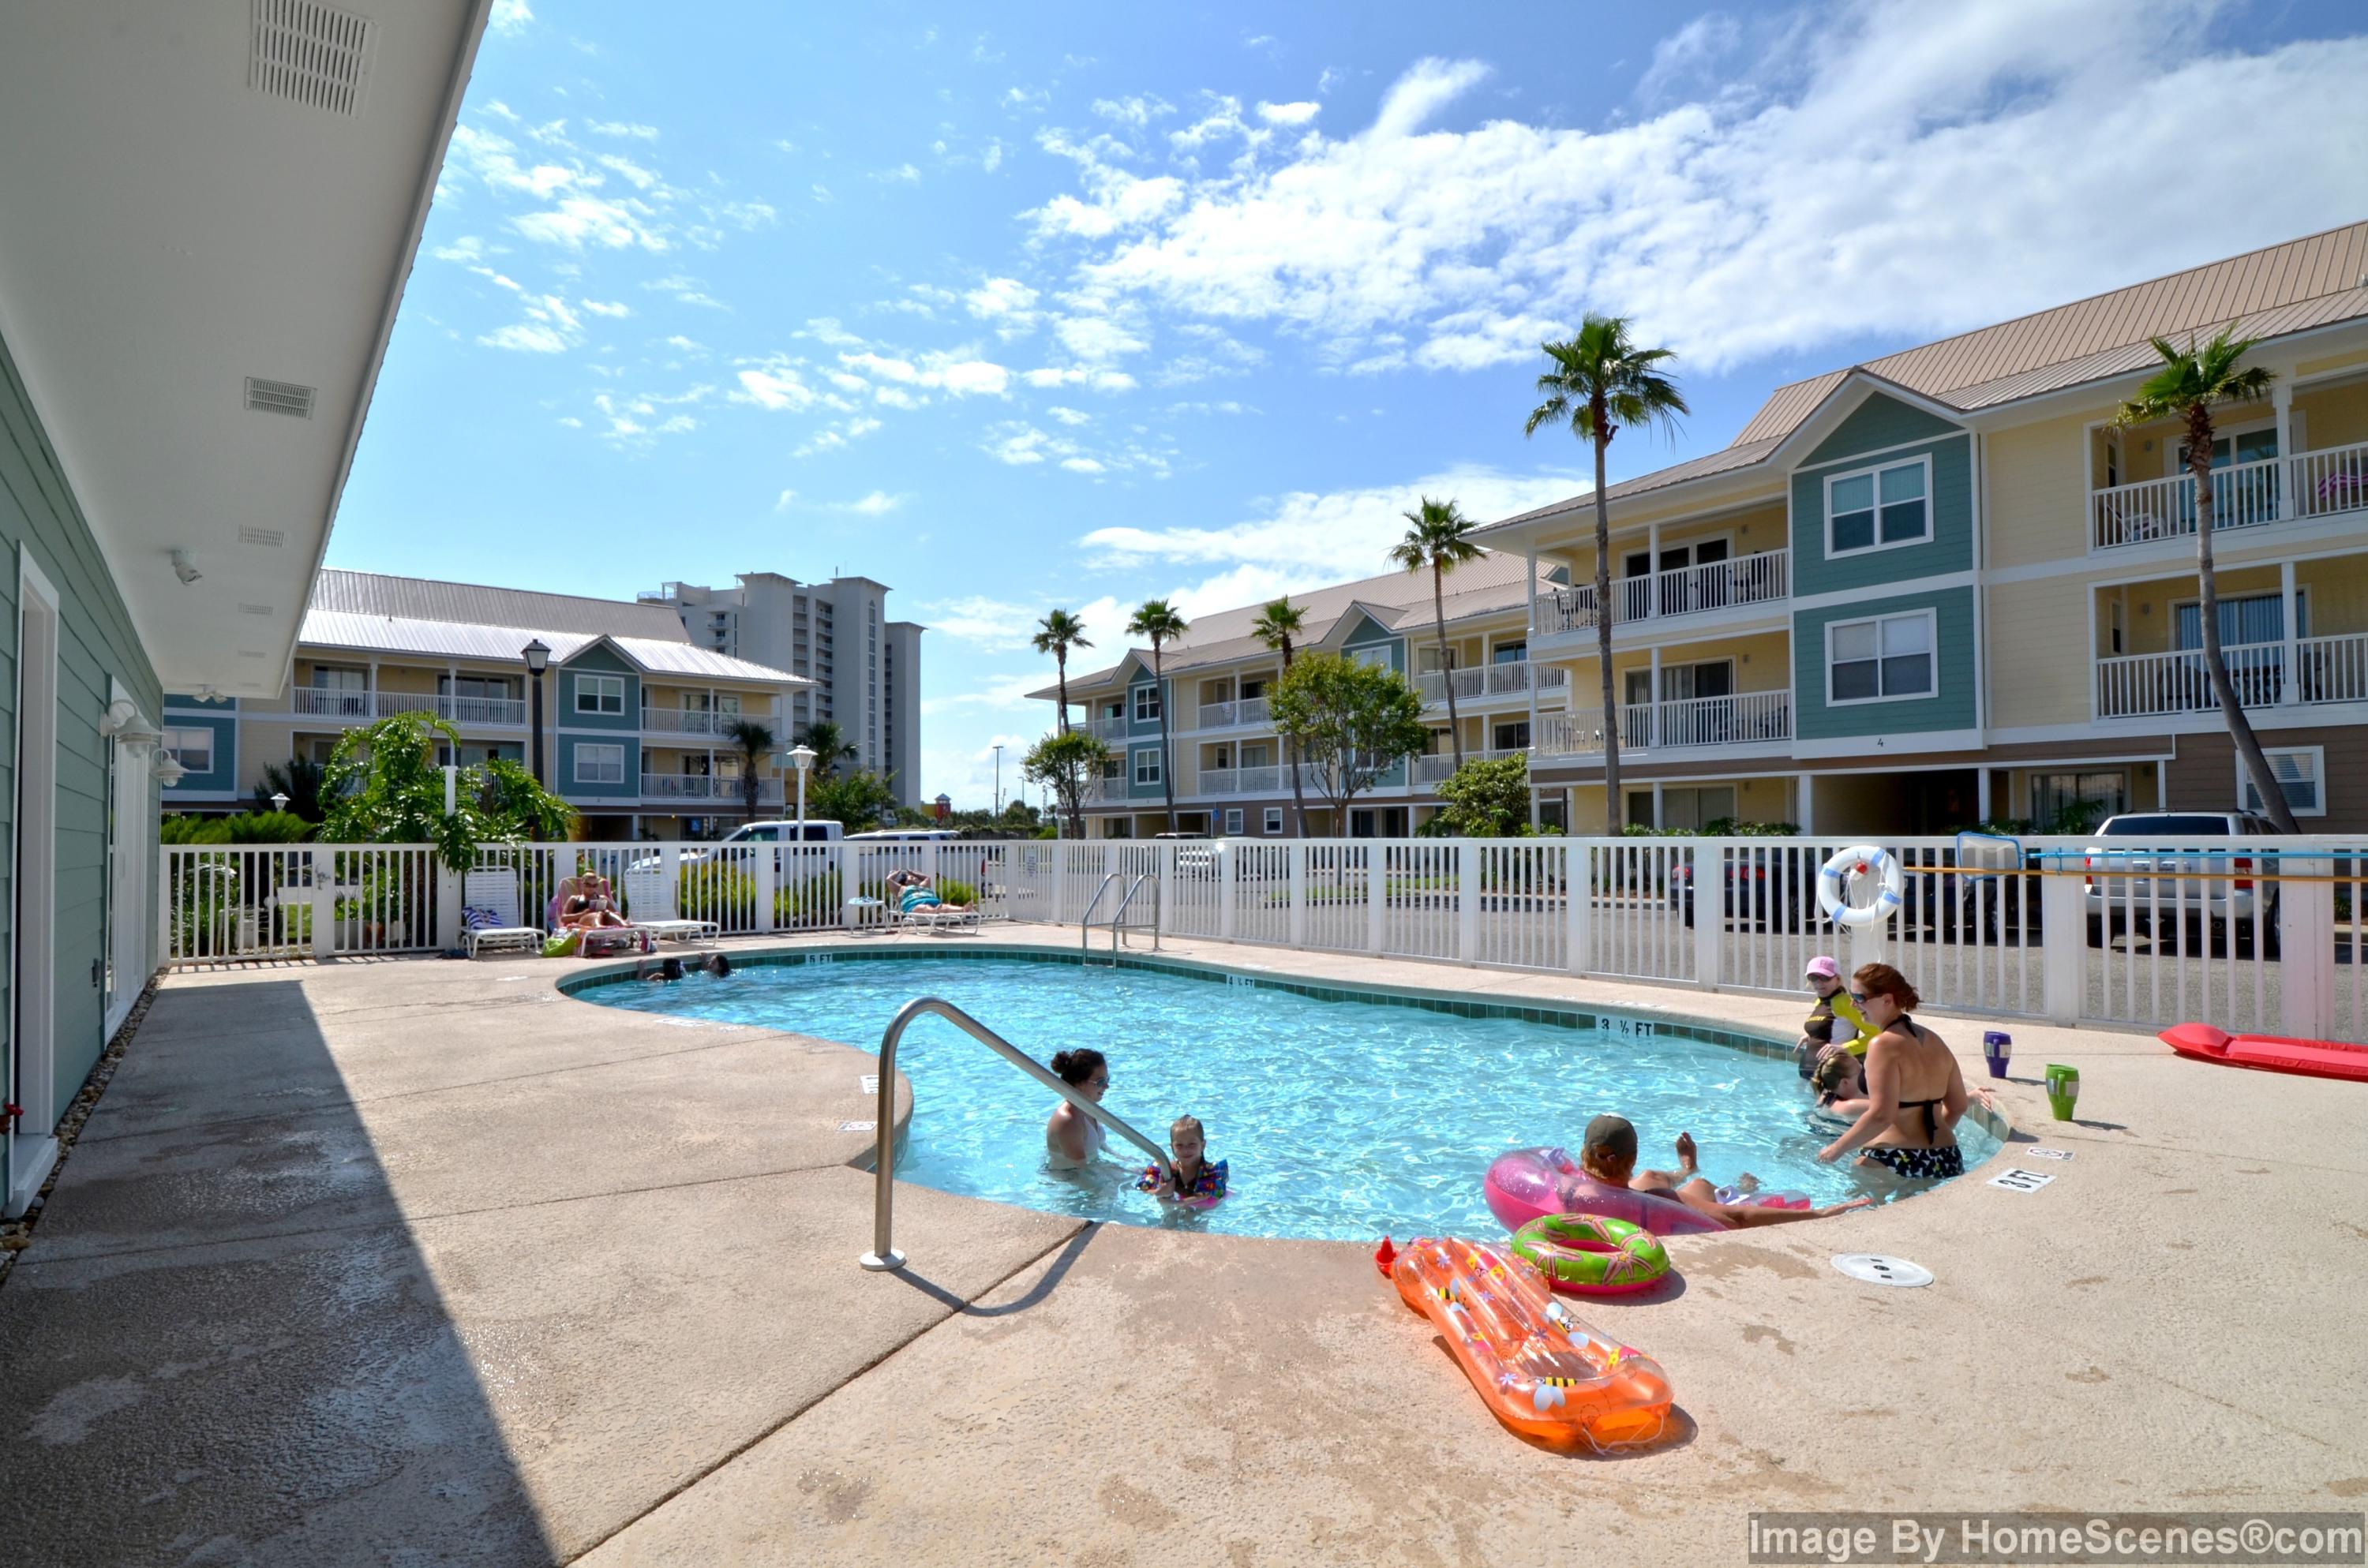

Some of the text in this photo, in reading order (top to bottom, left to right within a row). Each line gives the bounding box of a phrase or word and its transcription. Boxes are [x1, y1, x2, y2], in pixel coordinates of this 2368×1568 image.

[1877, 738, 1883, 747] 4
[820, 954, 831, 964] FT
[1602, 1019, 1609, 1030] 3
[1635, 1022, 1651, 1035] FT
[1998, 1169, 2048, 1188] 3 FT
